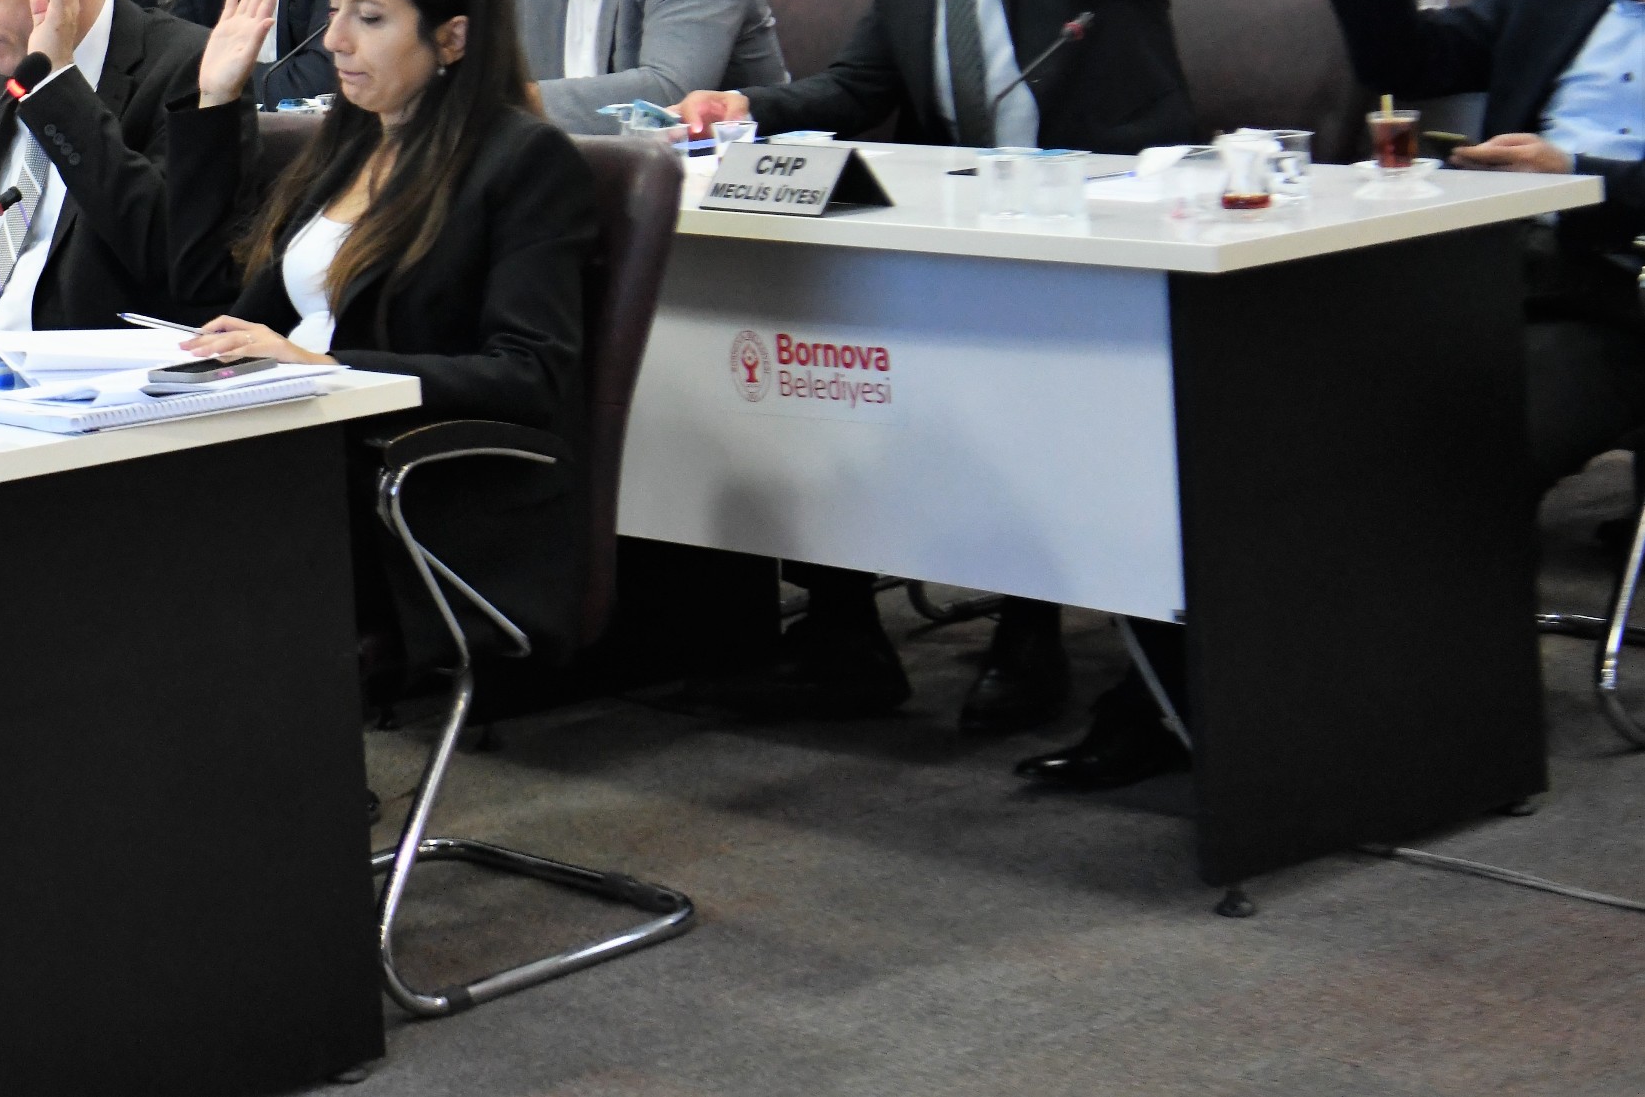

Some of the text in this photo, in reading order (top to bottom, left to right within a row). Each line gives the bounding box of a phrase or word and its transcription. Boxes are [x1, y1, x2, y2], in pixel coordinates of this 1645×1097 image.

[755, 154, 806, 177] CHP
[710, 182, 828, 206] MECLİS ÜYESİ
[776, 333, 891, 372] Bornova
[778, 370, 892, 409] Belediyesi
